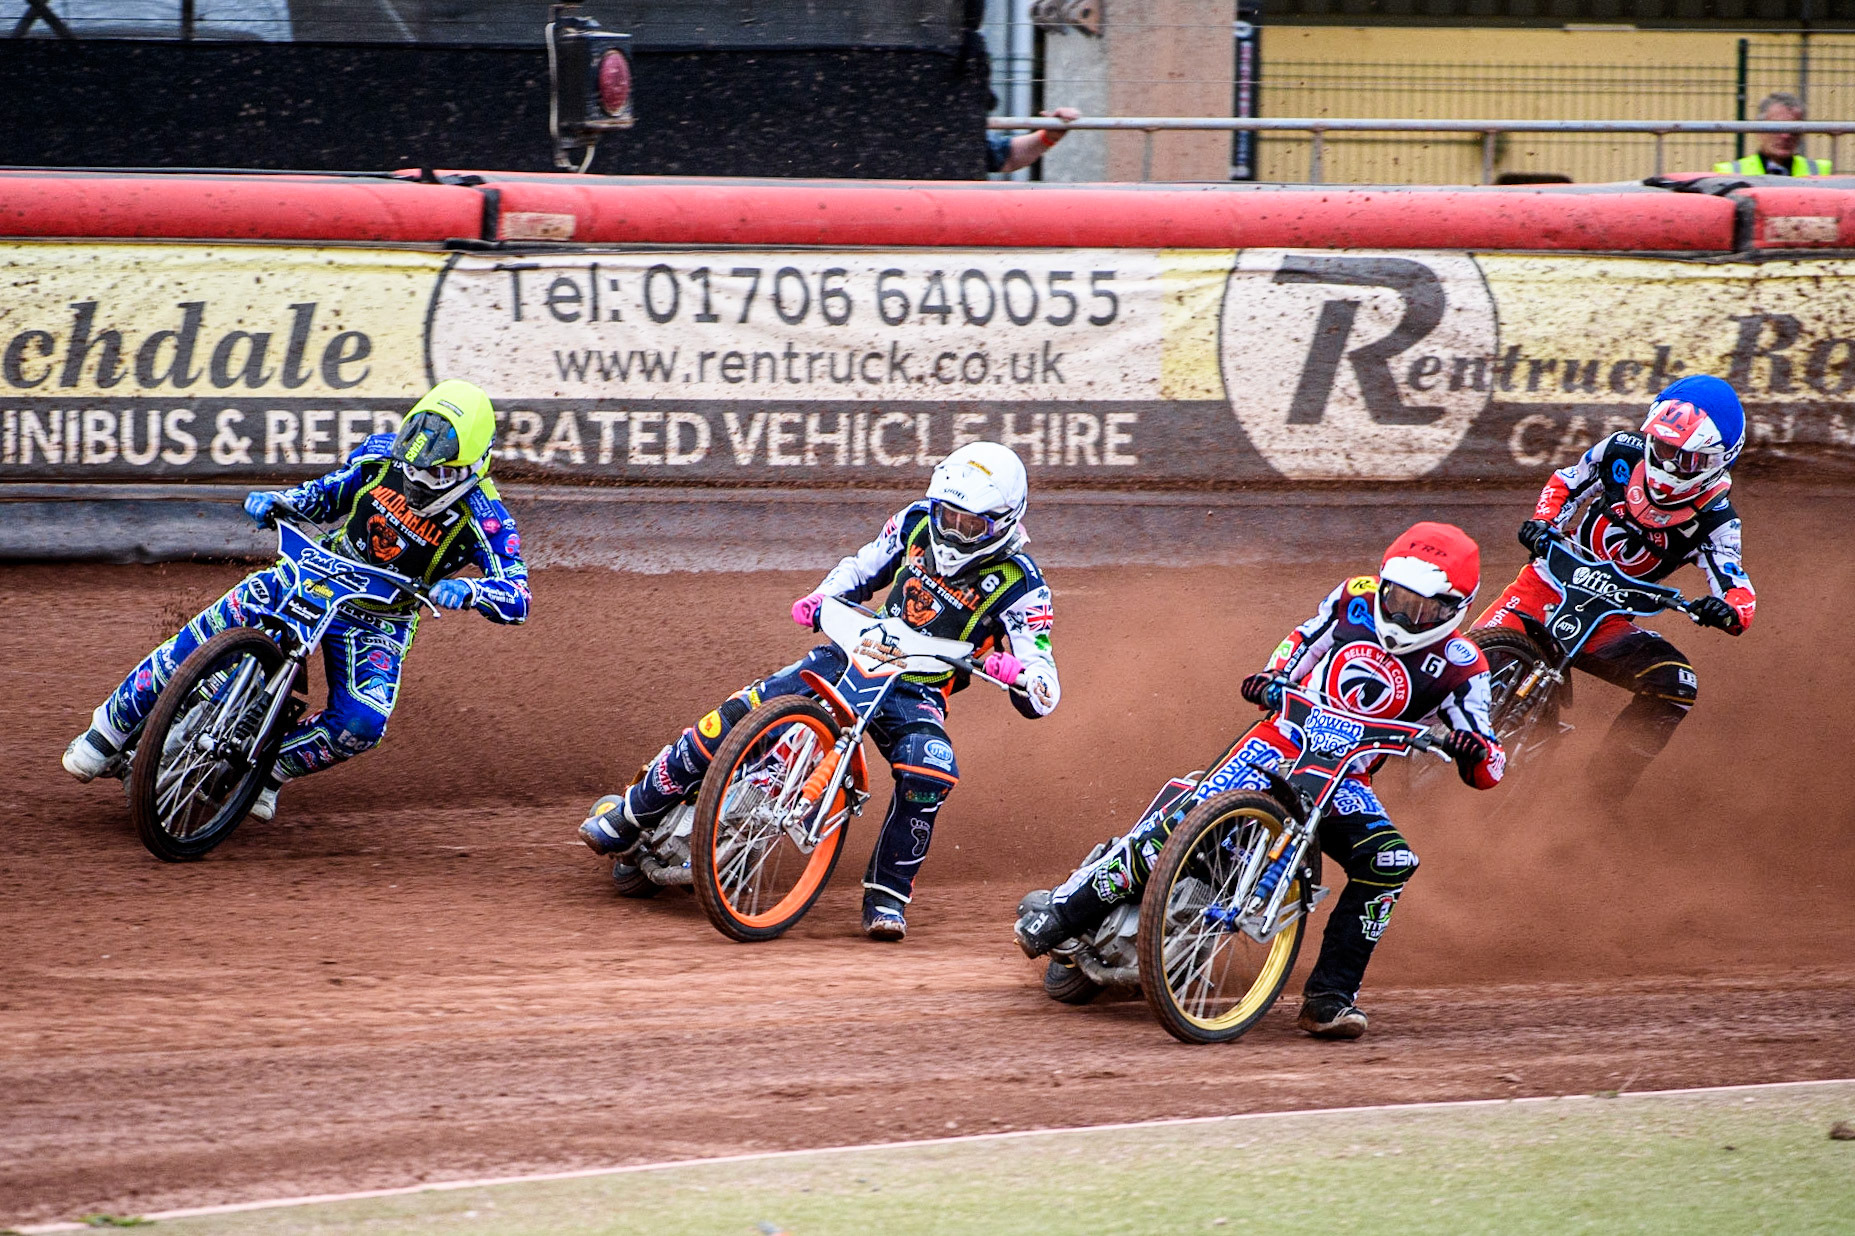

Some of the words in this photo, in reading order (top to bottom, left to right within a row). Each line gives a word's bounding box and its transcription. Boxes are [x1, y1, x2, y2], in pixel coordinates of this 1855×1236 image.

[492, 262, 621, 322] Tel:
[643, 263, 850, 326] 01706
[876, 267, 1119, 328] 640055
[3, 300, 373, 389] chdale
[553, 339, 1066, 385] www.rentruck.co.uk
[2, 408, 198, 465] INIBUS
[210, 408, 252, 465] &
[722, 410, 988, 467] VEHICLE
[1001, 412, 1139, 466] HIRE
[404, 431, 428, 463] ASTARS
[943, 487, 966, 500] SHOEI
[442, 509, 460, 527] 7
[355, 538, 367, 551] 20
[400, 524, 428, 547] TIGERS
[981, 573, 1001, 593] 6
[1572, 566, 1629, 603] Office
[936, 586, 964, 610] TIGERS
[890, 603, 902, 617] 20
[1556, 621, 1577, 634] ATPI
[1452, 642, 1472, 660] ATPI
[1343, 647, 1373, 661] BELLE
[1391, 668, 1406, 700] COLTS
[1425, 656, 1442, 676] 6
[1306, 708, 1362, 737] Bowen
[1313, 732, 1345, 754] Pies
[1197, 739, 1268, 799] Bowen
[1376, 850, 1420, 867] BSN
